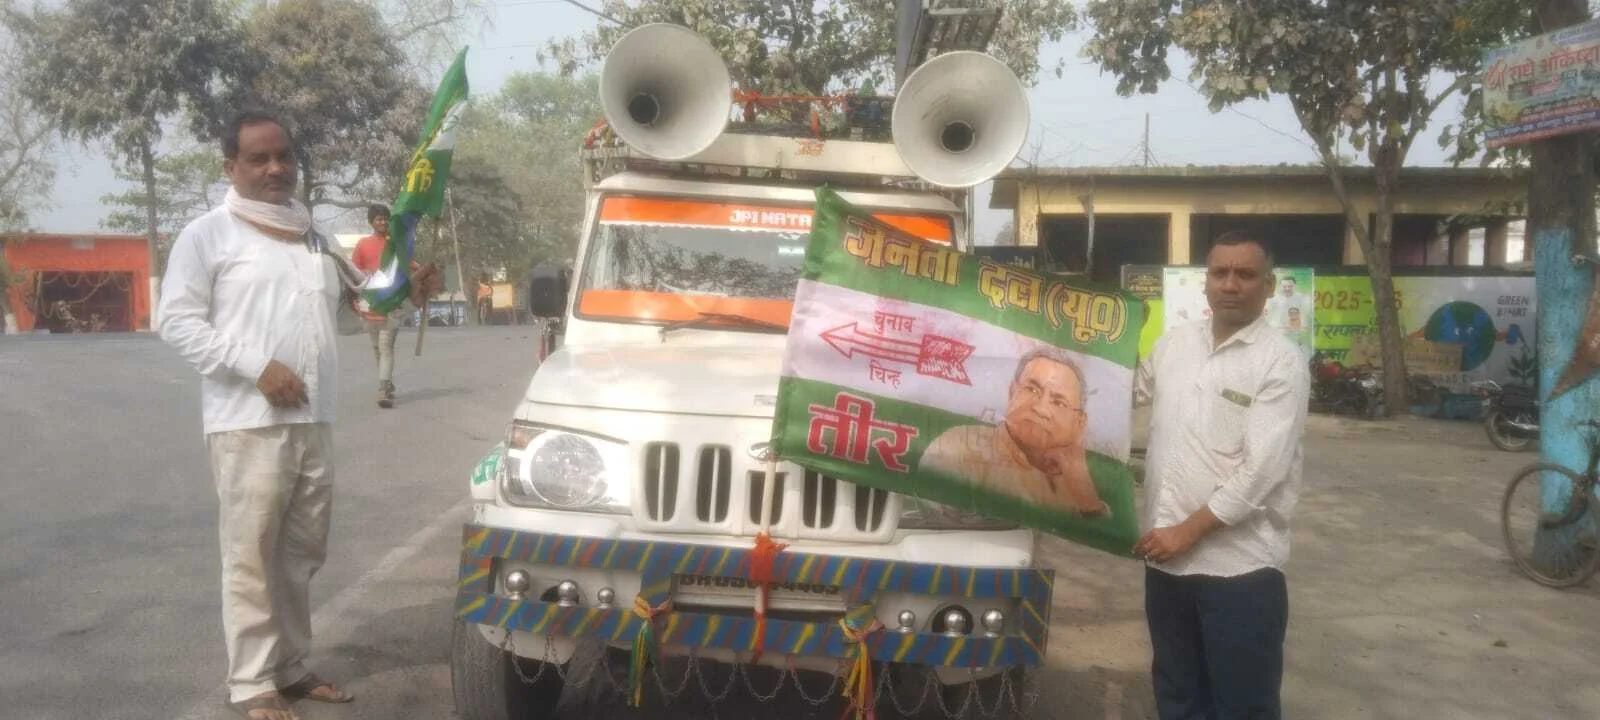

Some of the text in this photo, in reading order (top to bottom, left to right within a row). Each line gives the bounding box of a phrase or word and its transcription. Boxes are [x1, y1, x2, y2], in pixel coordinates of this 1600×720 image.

[843, 213, 964, 286] जनता
[976, 262, 1044, 314] दल
[1497, 295, 1530, 306] GREEN
[873, 310, 917, 334] चुनाव
[869, 359, 903, 388] चिन्ह
[807, 391, 920, 473] तीर
